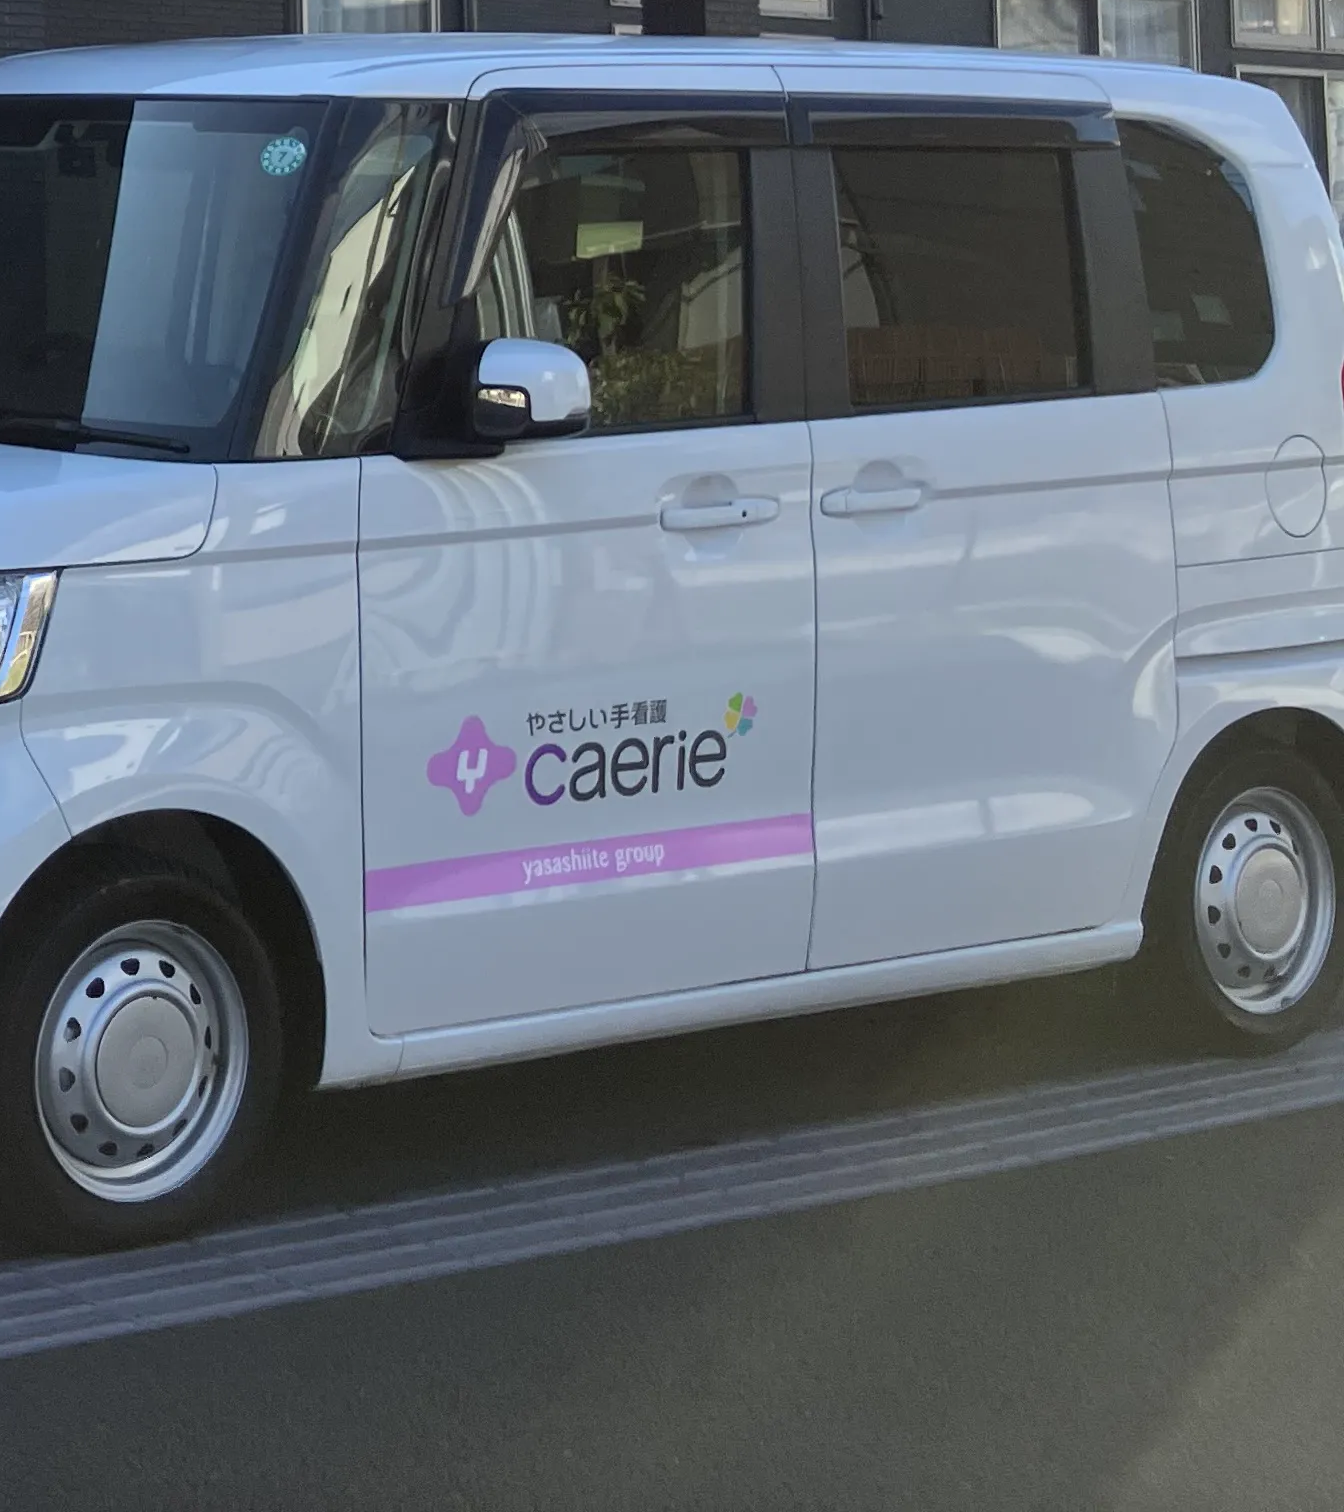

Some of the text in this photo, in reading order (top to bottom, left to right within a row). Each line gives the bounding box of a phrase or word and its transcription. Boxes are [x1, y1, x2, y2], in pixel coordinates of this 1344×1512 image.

[525, 698, 668, 736] やさしい手看護
[524, 729, 728, 806] caerie
[522, 843, 666, 885] yasashiite group
